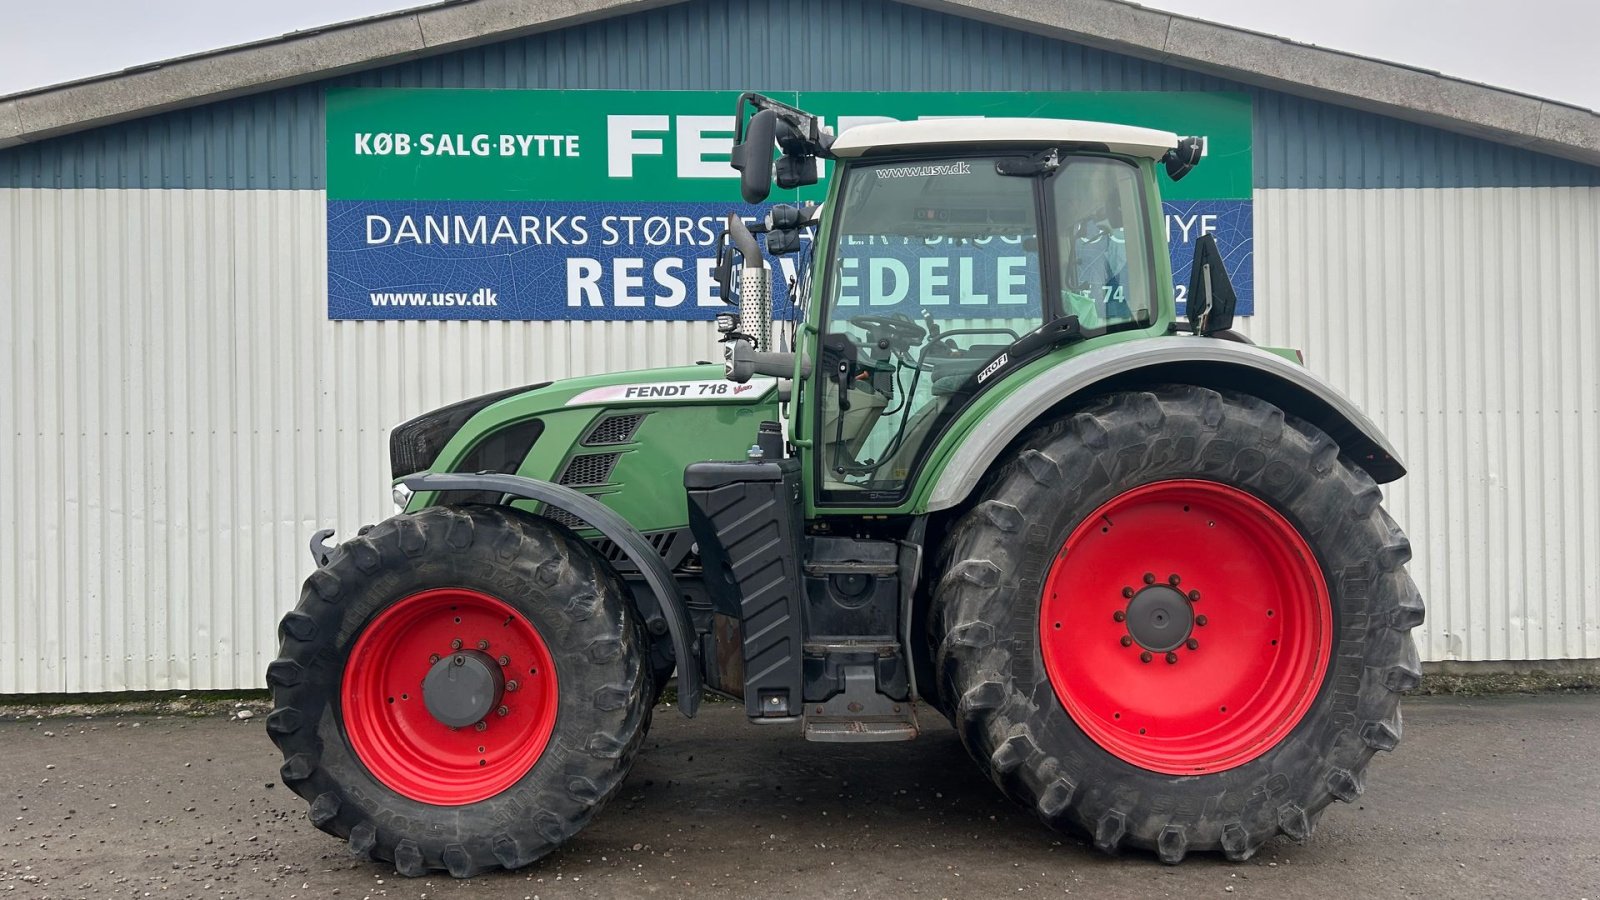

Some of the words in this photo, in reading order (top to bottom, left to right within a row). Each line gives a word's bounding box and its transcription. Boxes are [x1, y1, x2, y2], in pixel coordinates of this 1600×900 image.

[875, 161, 971, 179] www.usv.dk
[366, 215, 588, 245] DANMARKS
[601, 215, 757, 246] STØRST
[566, 256, 1028, 308] RESEVEDELE
[370, 288, 498, 306] www.usv.dk
[978, 354, 1008, 382] PROFI
[625, 384, 690, 398] FENDT
[698, 383, 728, 395] 718
